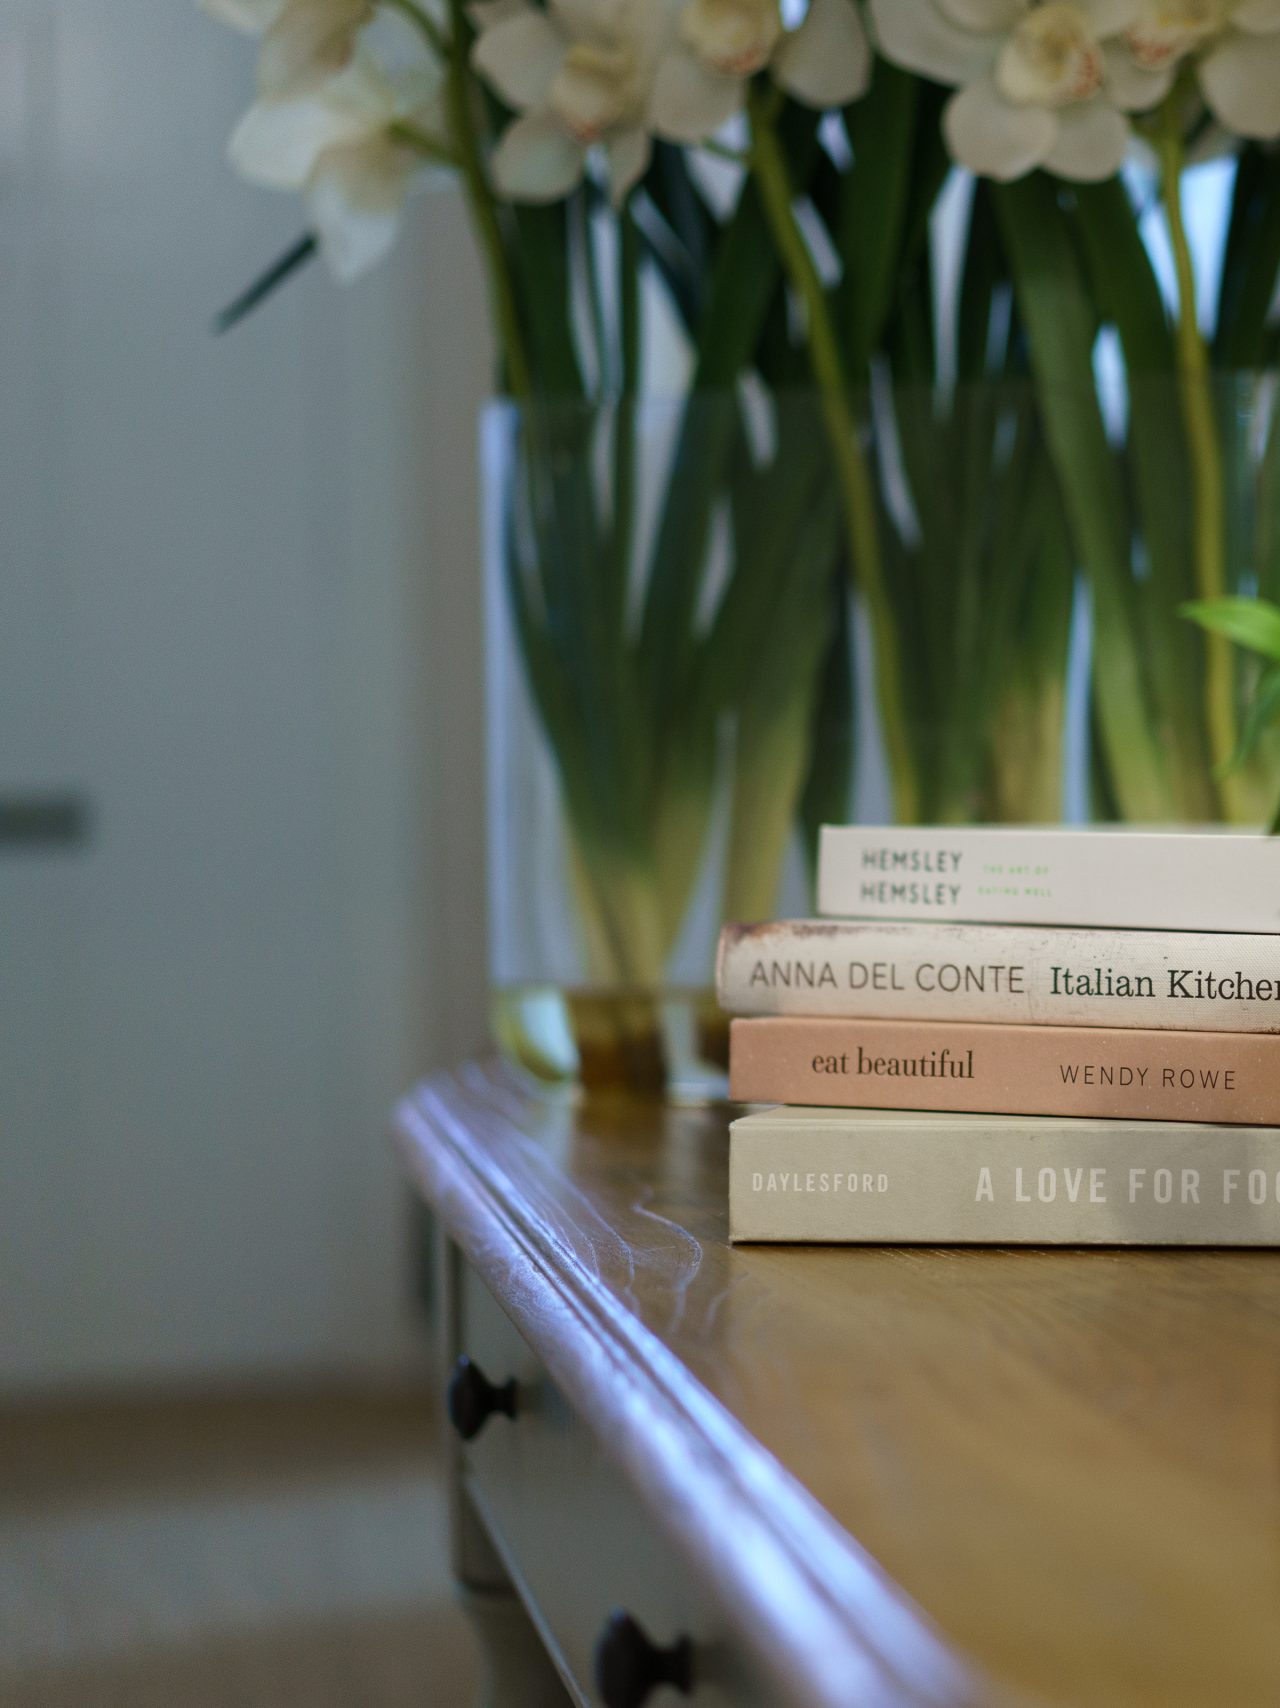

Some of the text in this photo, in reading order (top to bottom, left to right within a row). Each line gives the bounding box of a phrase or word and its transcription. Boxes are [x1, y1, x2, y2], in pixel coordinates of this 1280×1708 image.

[862, 848, 963, 873] HEMSLEY
[860, 881, 961, 905] HEMSLEY
[751, 961, 1024, 993] ANNA DEL CONTE
[1050, 967, 1156, 998] Italian
[811, 1047, 975, 1079] eat beautiful
[1060, 1065, 1236, 1090] WENDY ROWE
[752, 1172, 889, 1193] DAYLESFORD
[974, 1167, 995, 1202] A
[1015, 1167, 1107, 1203] LOVE
[1129, 1168, 1201, 1204] FOR
